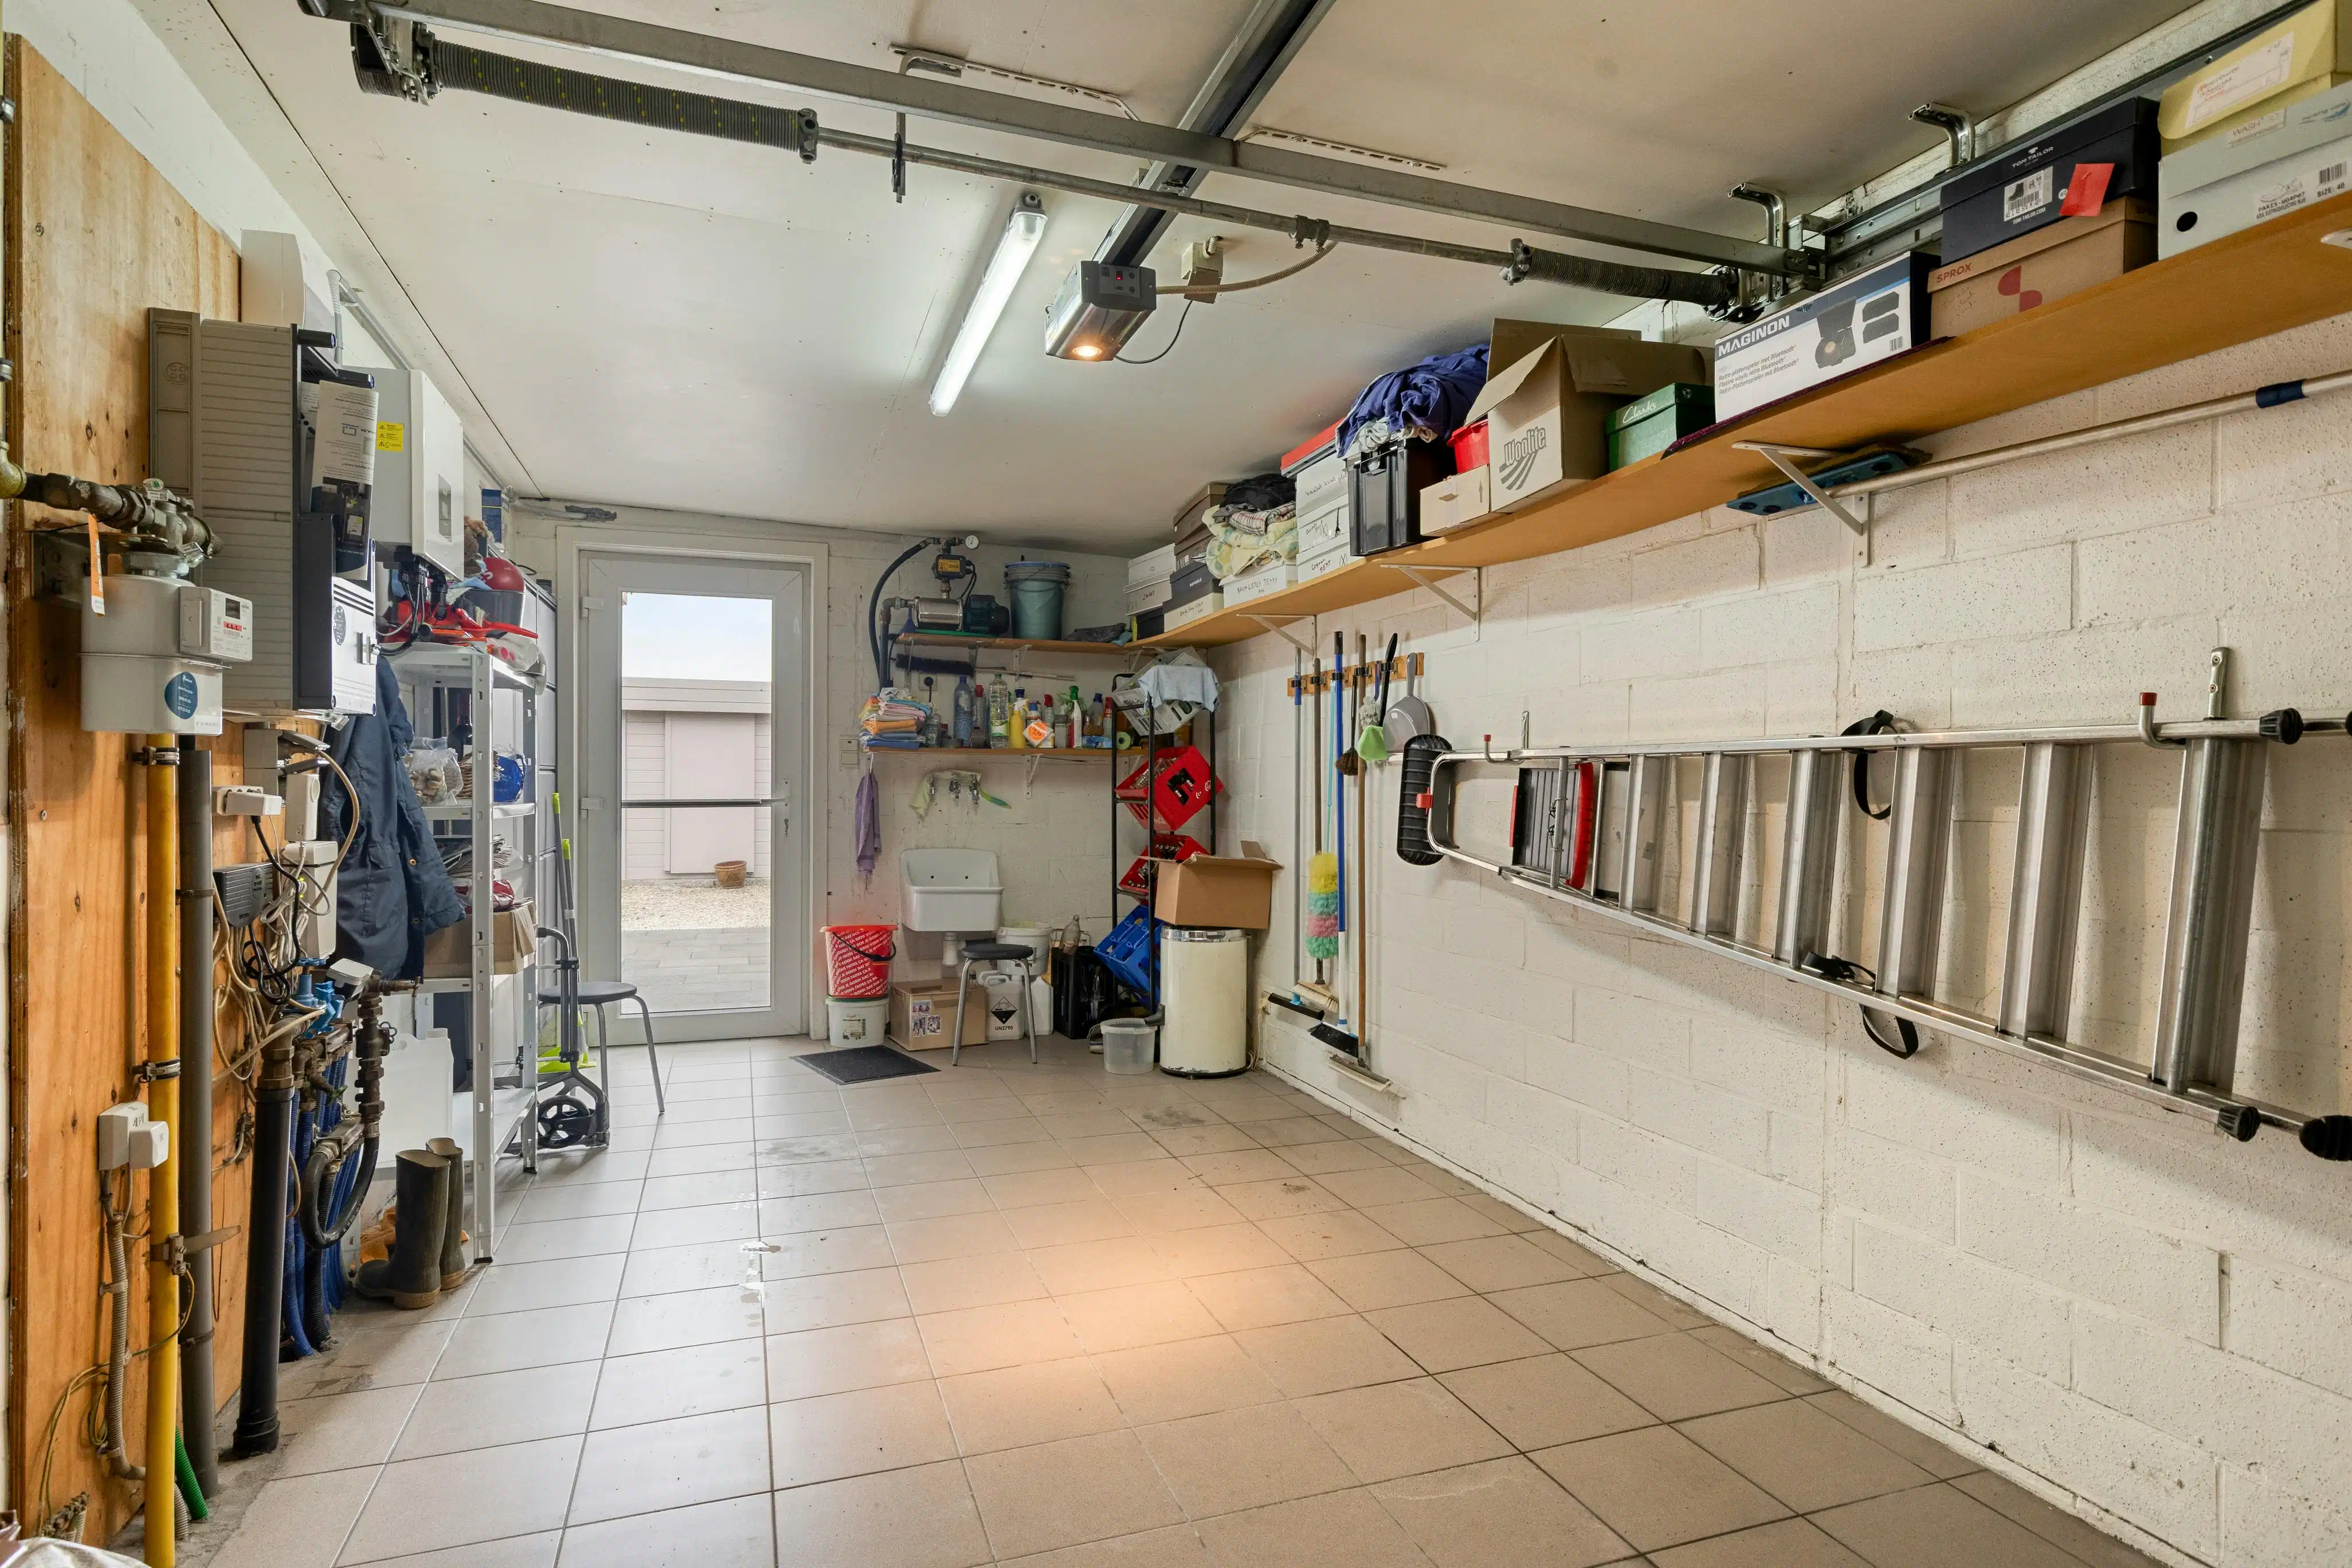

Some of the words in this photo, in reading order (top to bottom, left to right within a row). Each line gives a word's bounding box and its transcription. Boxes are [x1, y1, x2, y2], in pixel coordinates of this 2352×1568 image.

[2012, 158, 2028, 168] TOM
[2028, 146, 2054, 161] TAILOR
[1937, 262, 1972, 283] SPROX
[1719, 315, 1790, 356] MAGINON
[1760, 356, 1770, 364] met
[1719, 378, 1734, 389] Platine
[1734, 373, 1748, 383] vinyle
[1764, 369, 1773, 378] mit
[1622, 401, 1656, 424] Clarks
[1504, 426, 1546, 468] Woolite
